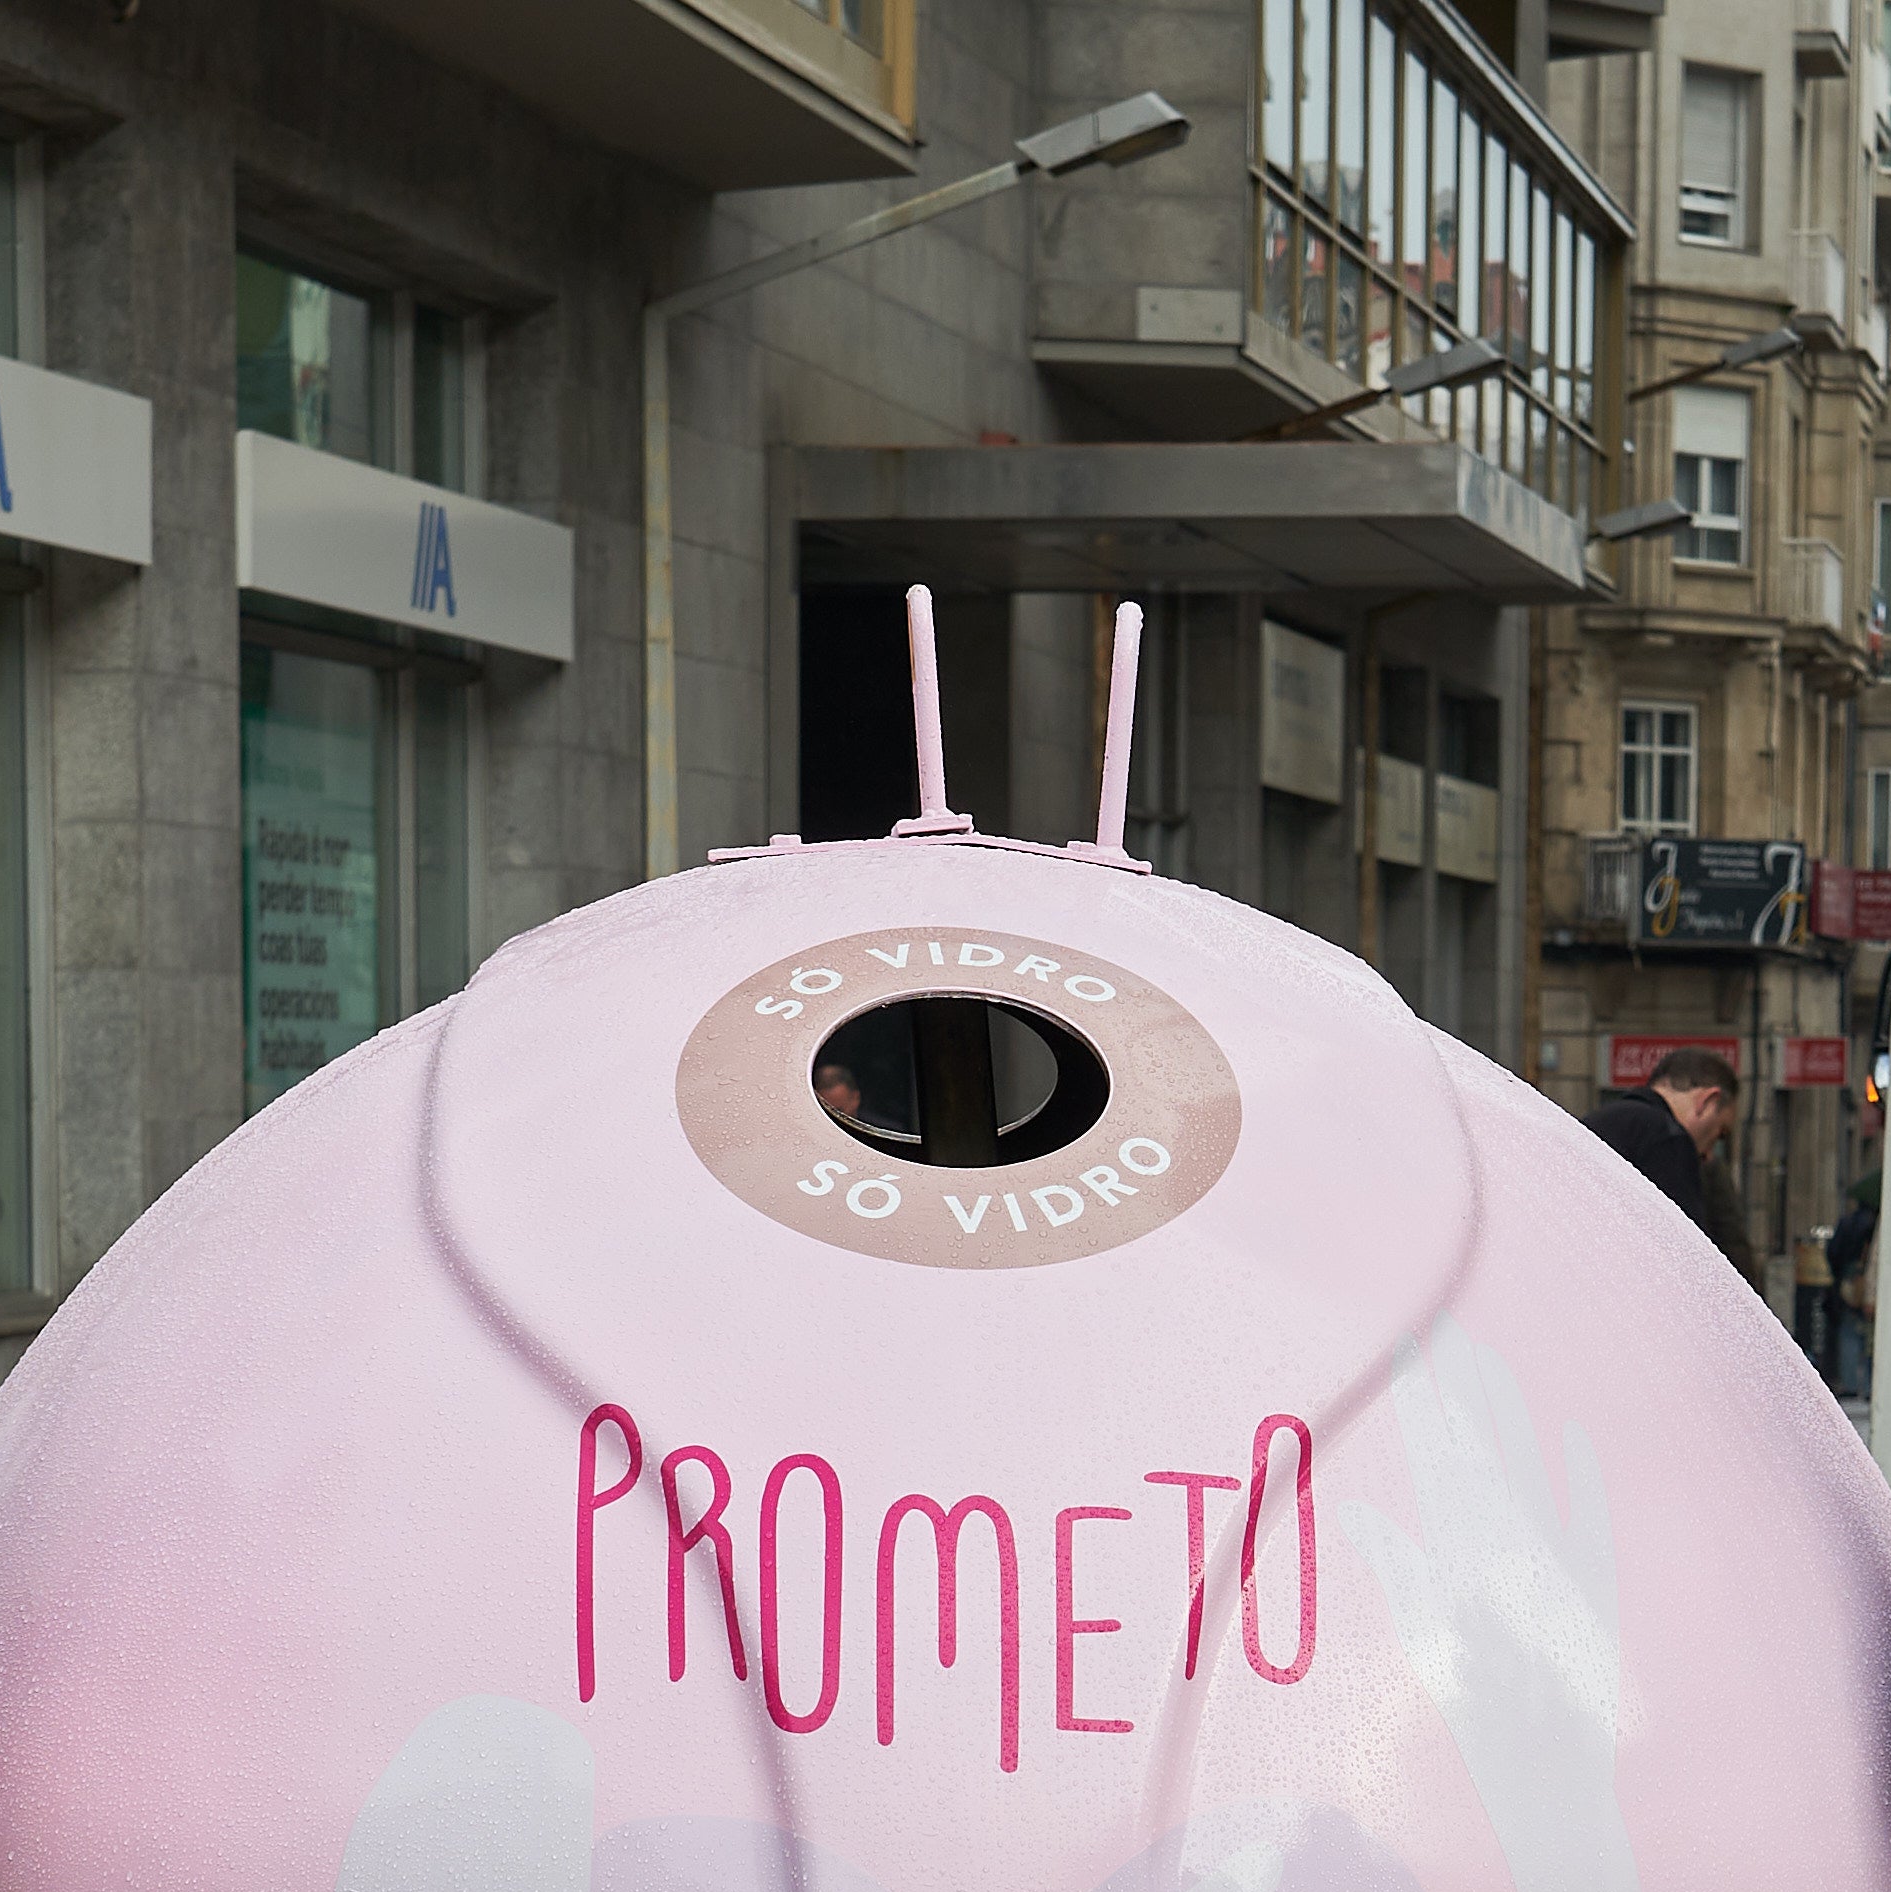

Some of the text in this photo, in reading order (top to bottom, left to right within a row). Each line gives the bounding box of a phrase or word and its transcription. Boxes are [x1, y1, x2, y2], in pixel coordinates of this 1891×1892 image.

[755, 940, 1117, 1021] SÓ VIDRO
[796, 1136, 1172, 1234] SÓ VIDRO
[575, 1402, 1317, 1774] PROMETO
